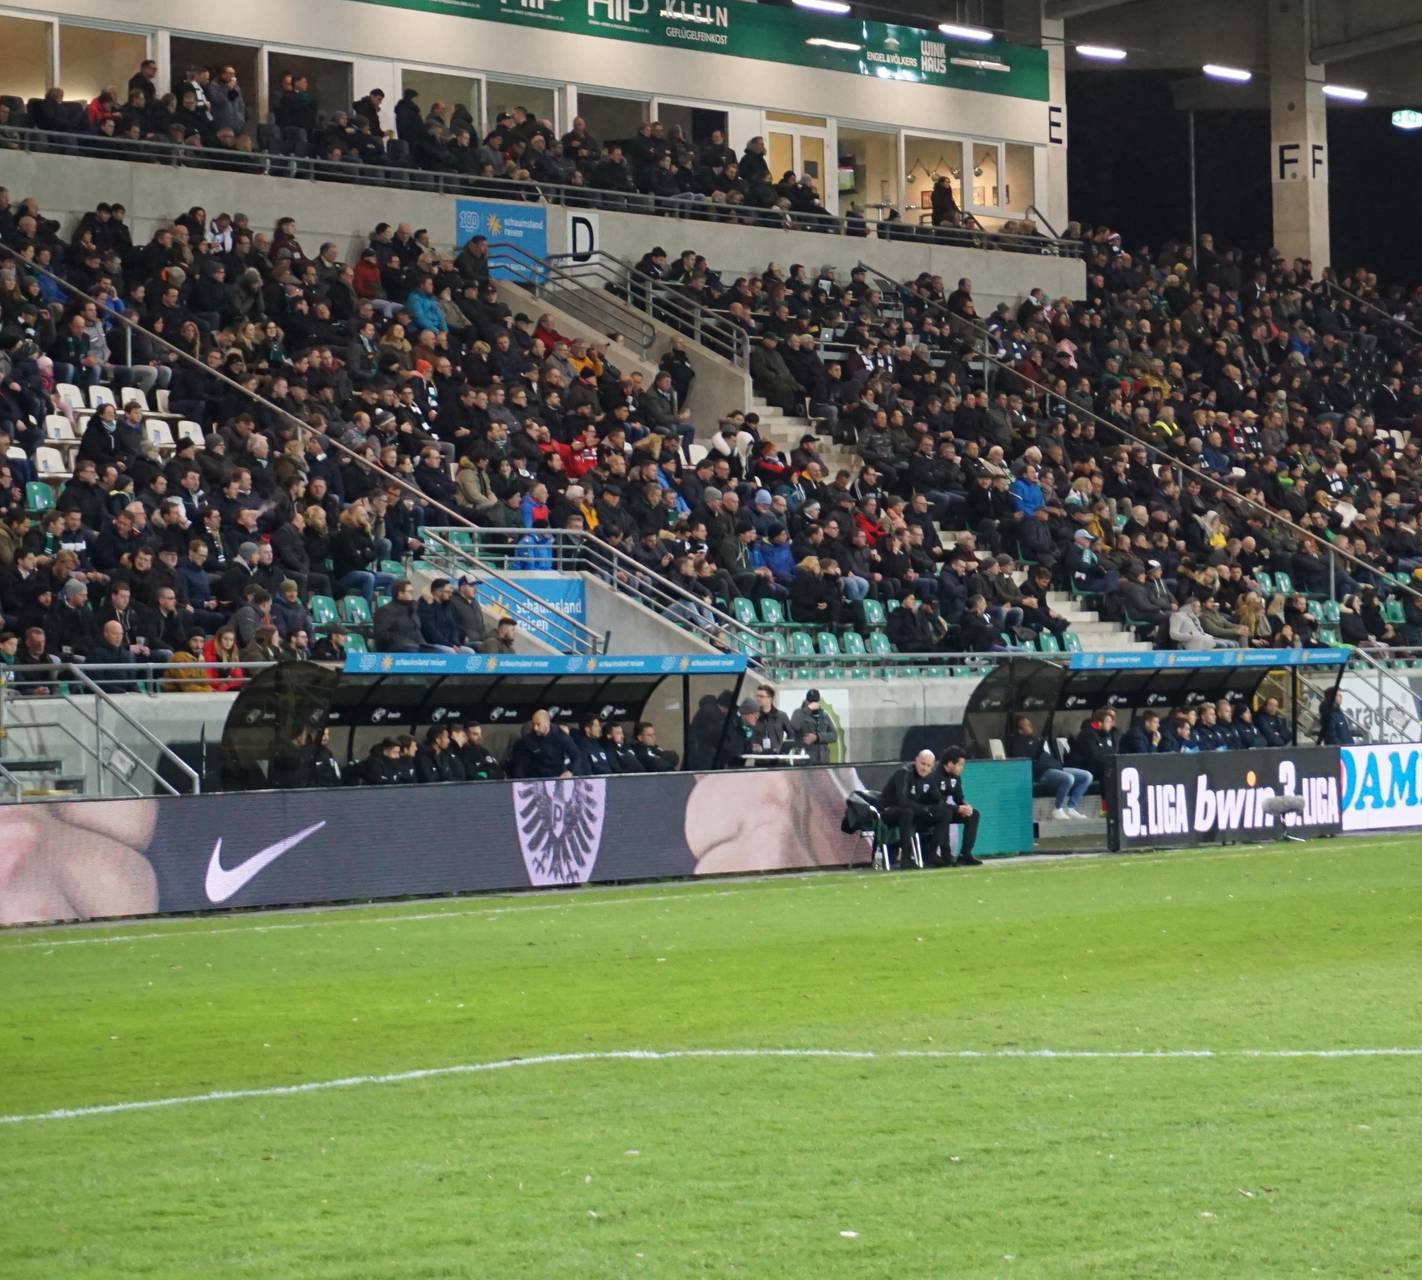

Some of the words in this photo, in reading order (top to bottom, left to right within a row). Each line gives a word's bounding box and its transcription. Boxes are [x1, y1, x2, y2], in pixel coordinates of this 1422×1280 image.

[665, 0, 728, 28] KLEIN
[920, 40, 946, 58] WINK
[920, 56, 947, 74] HAUS
[1048, 105, 1063, 144] E
[1278, 144, 1300, 180] F
[1311, 144, 1324, 179] F
[572, 216, 594, 262] D
[1194, 771, 1276, 833] bwin
